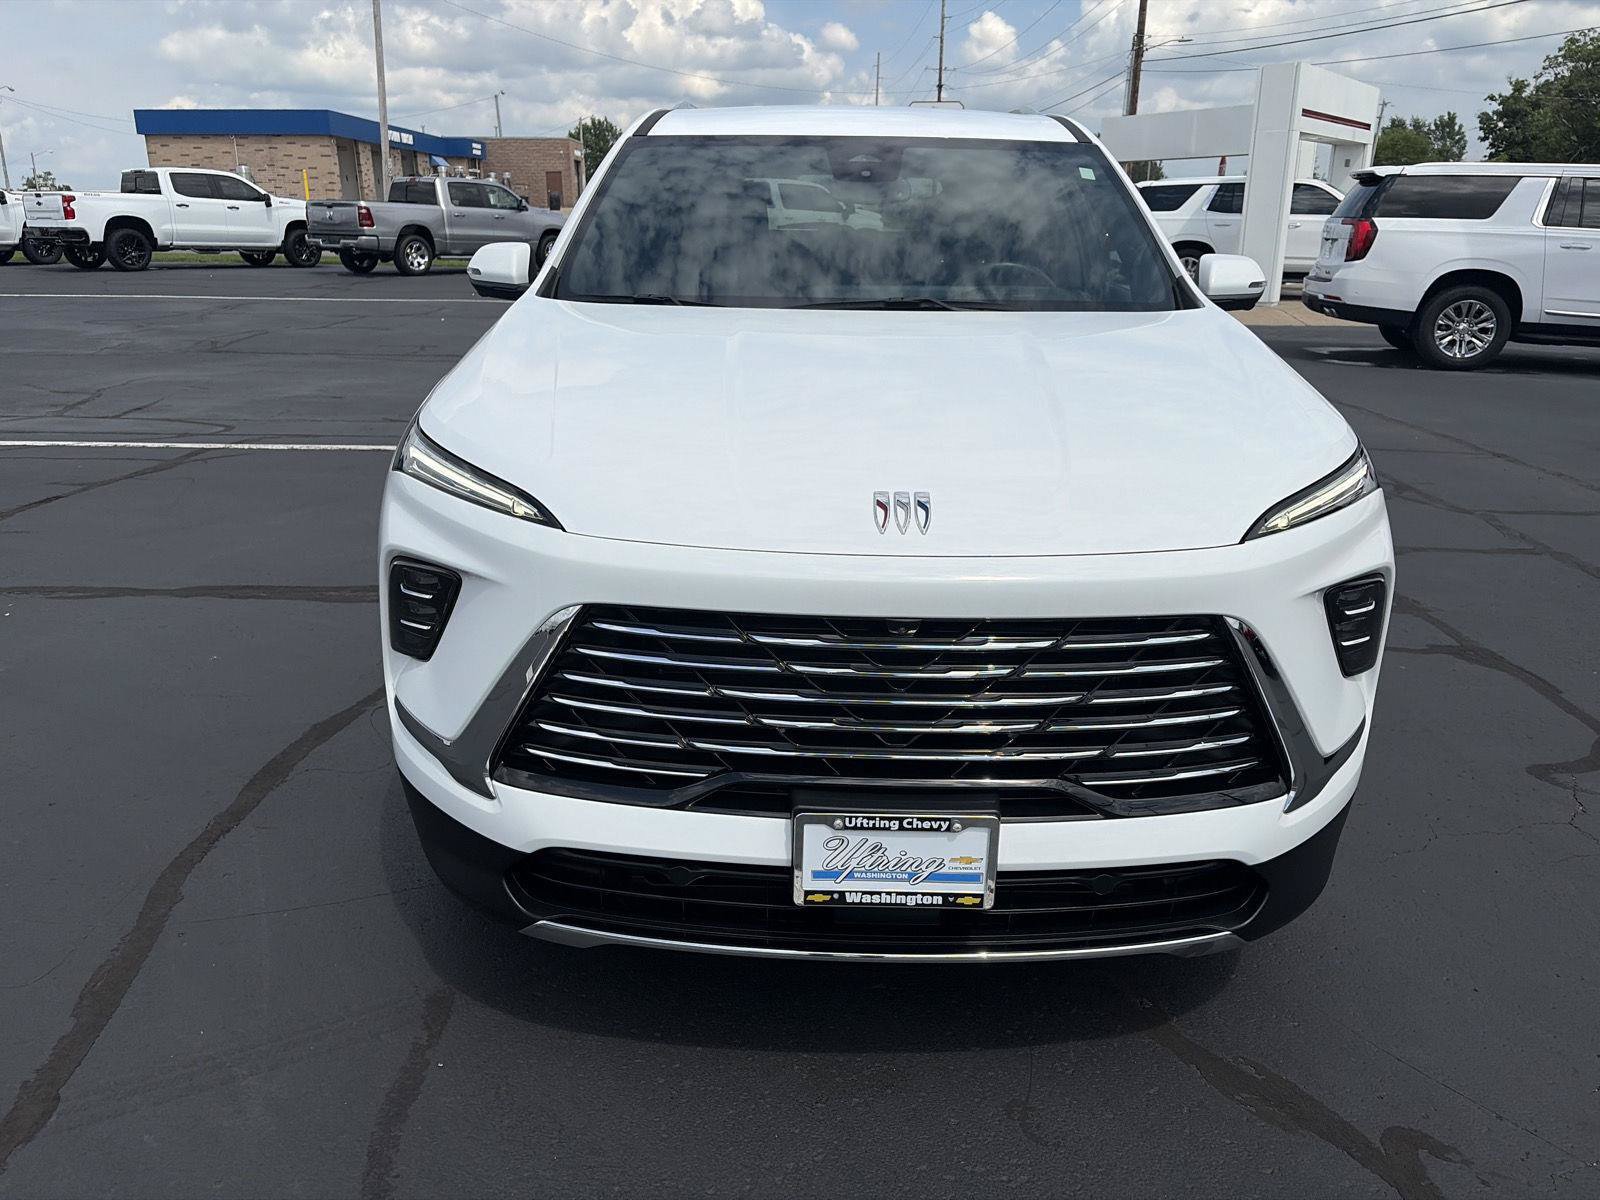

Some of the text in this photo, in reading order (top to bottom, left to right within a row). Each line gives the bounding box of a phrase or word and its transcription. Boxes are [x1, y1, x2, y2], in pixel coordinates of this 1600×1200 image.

[845, 817, 950, 832] Uftring Chevy
[822, 835, 945, 885] Uftring
[853, 872, 909, 880] WASHINGTON
[845, 892, 943, 906] Washington
